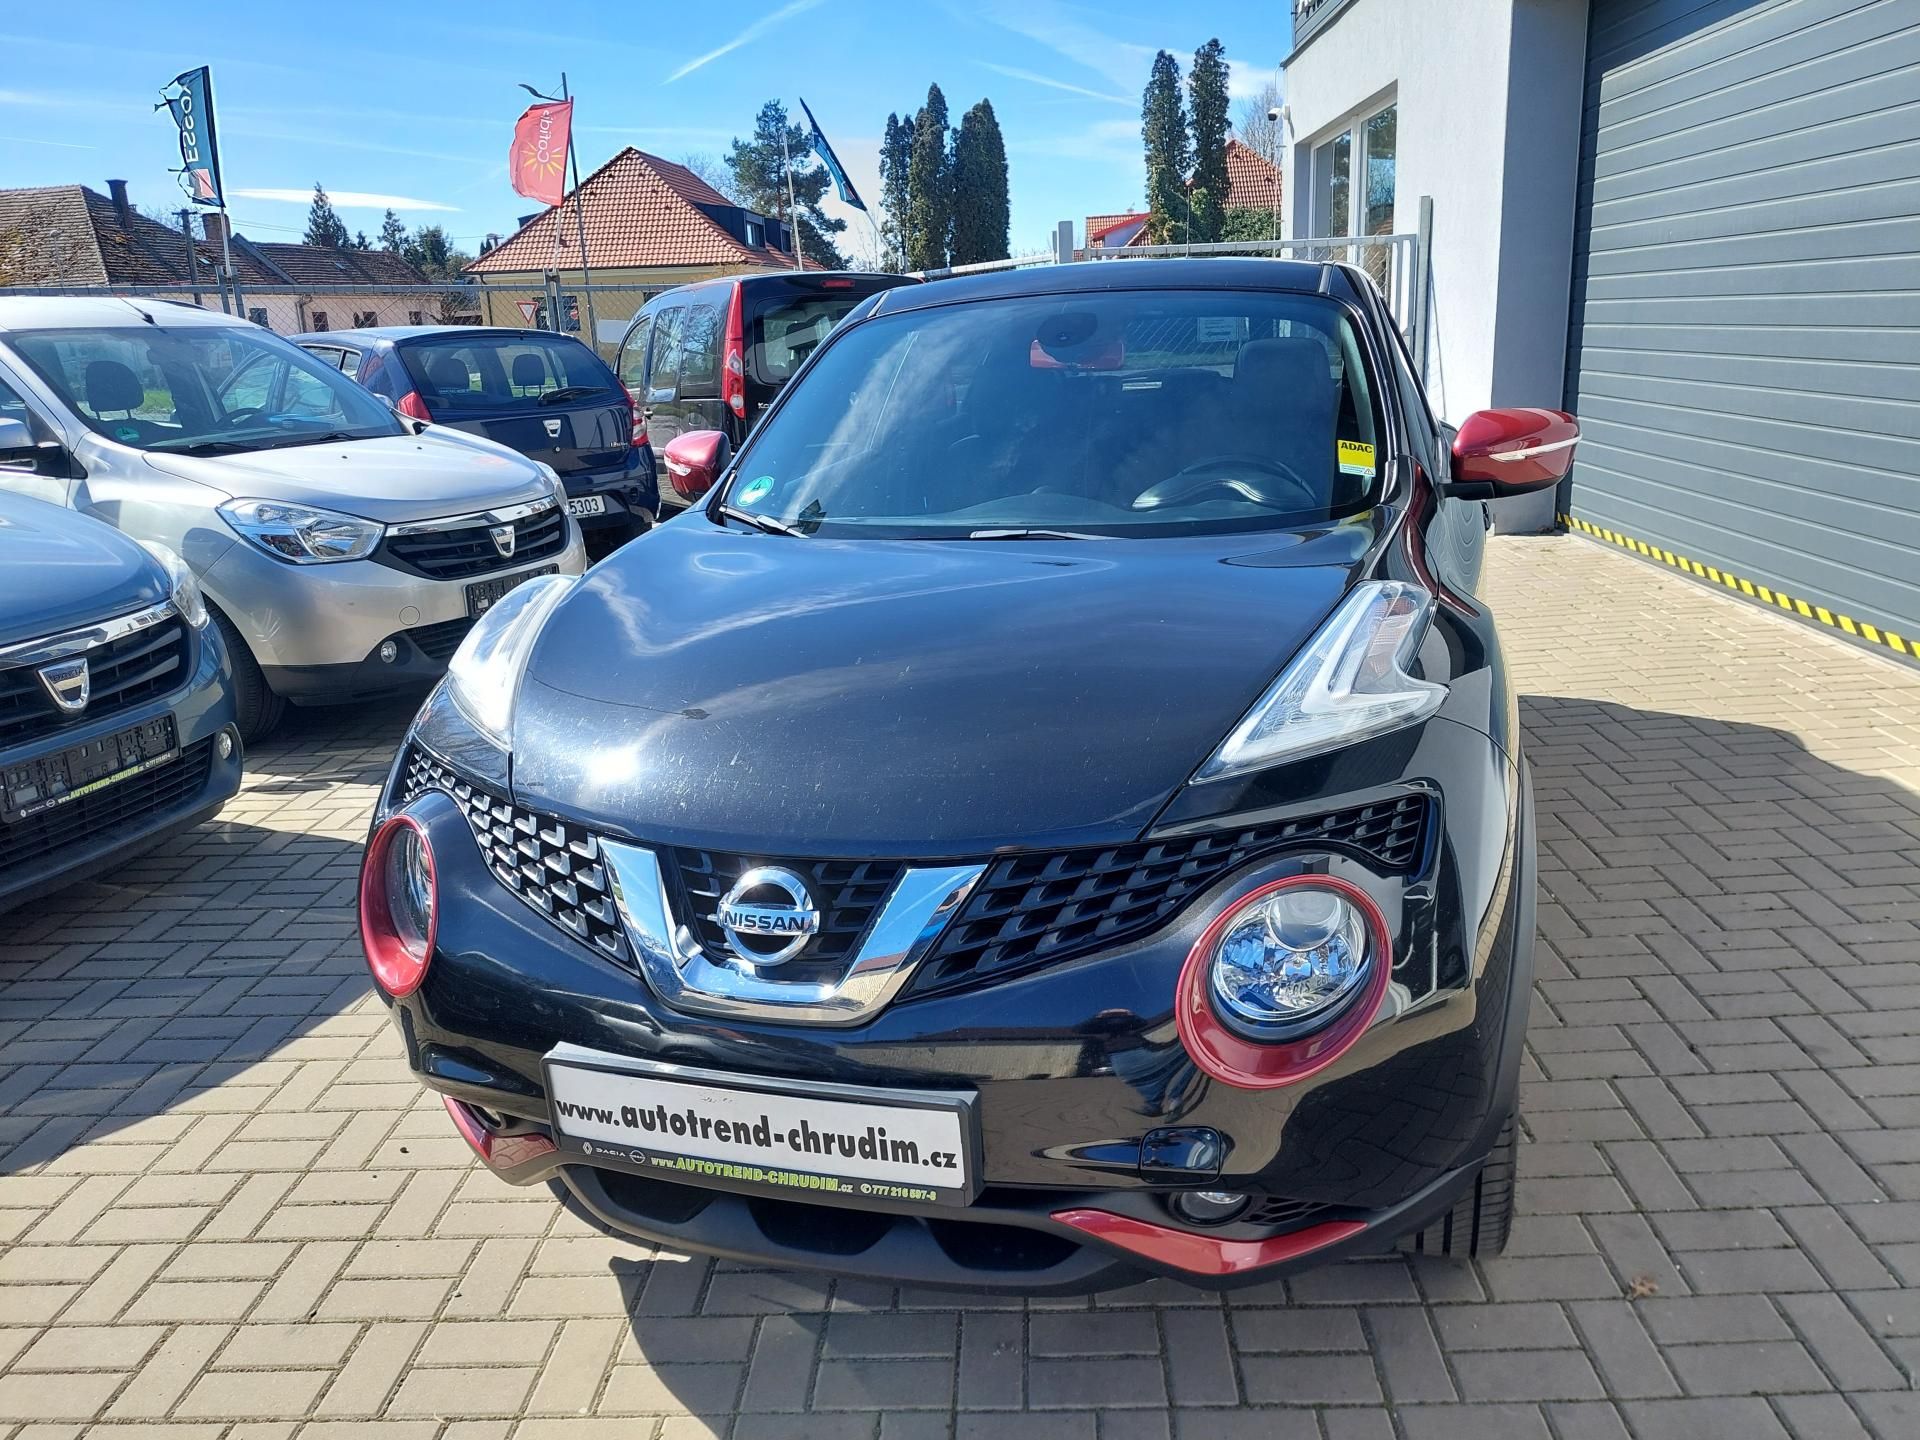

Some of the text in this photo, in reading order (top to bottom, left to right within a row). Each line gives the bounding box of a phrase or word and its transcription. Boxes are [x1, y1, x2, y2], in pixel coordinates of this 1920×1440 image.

[1341, 442, 1372, 453] ADAC
[569, 498, 599, 514] 5303
[724, 911, 804, 931] NISSAN
[555, 1098, 958, 1169] www.autotrend-chrudim.cz
[595, 1147, 626, 1157] DACIA
[872, 1184, 890, 1195] 777
